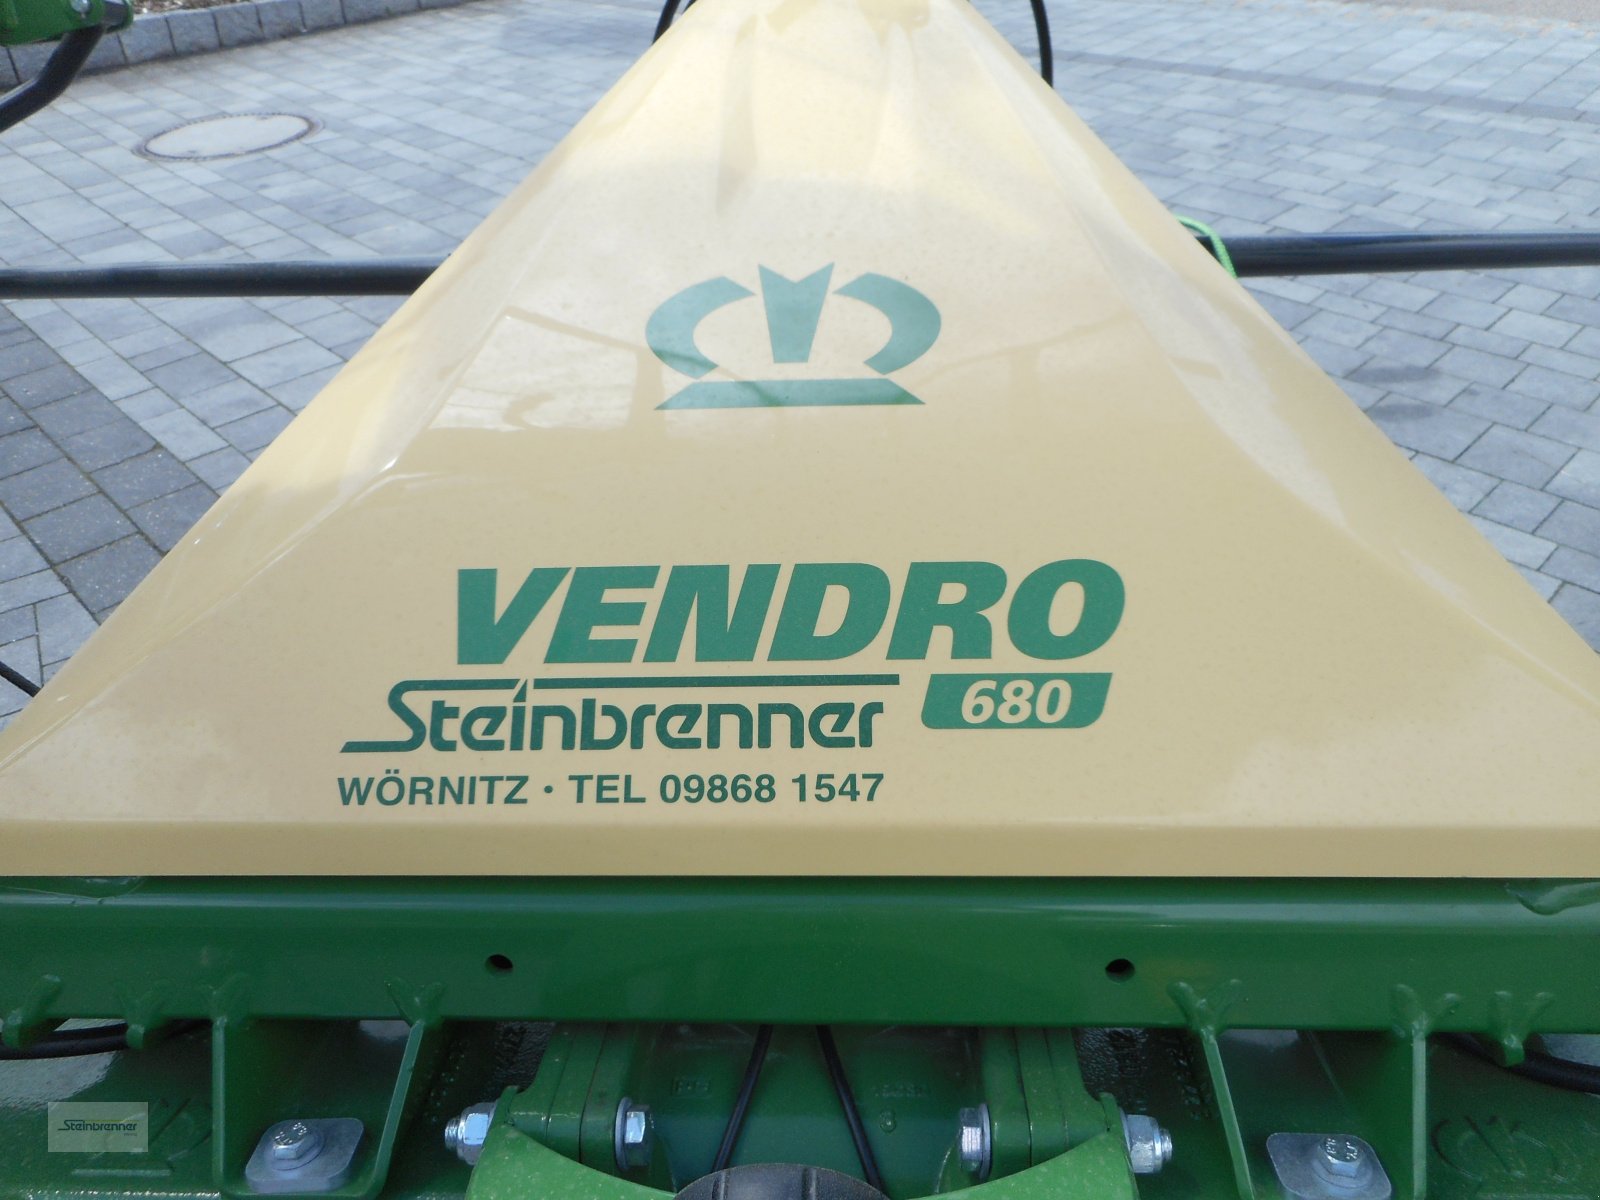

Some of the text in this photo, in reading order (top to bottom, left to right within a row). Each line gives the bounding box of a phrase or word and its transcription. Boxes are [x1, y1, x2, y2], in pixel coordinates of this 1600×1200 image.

[456, 558, 1125, 665] VENDRO
[340, 673, 900, 753] Steinbrenner
[961, 678, 1073, 724] 680
[338, 769, 885, 805] WÖRNITZ TEL 09868 1547
